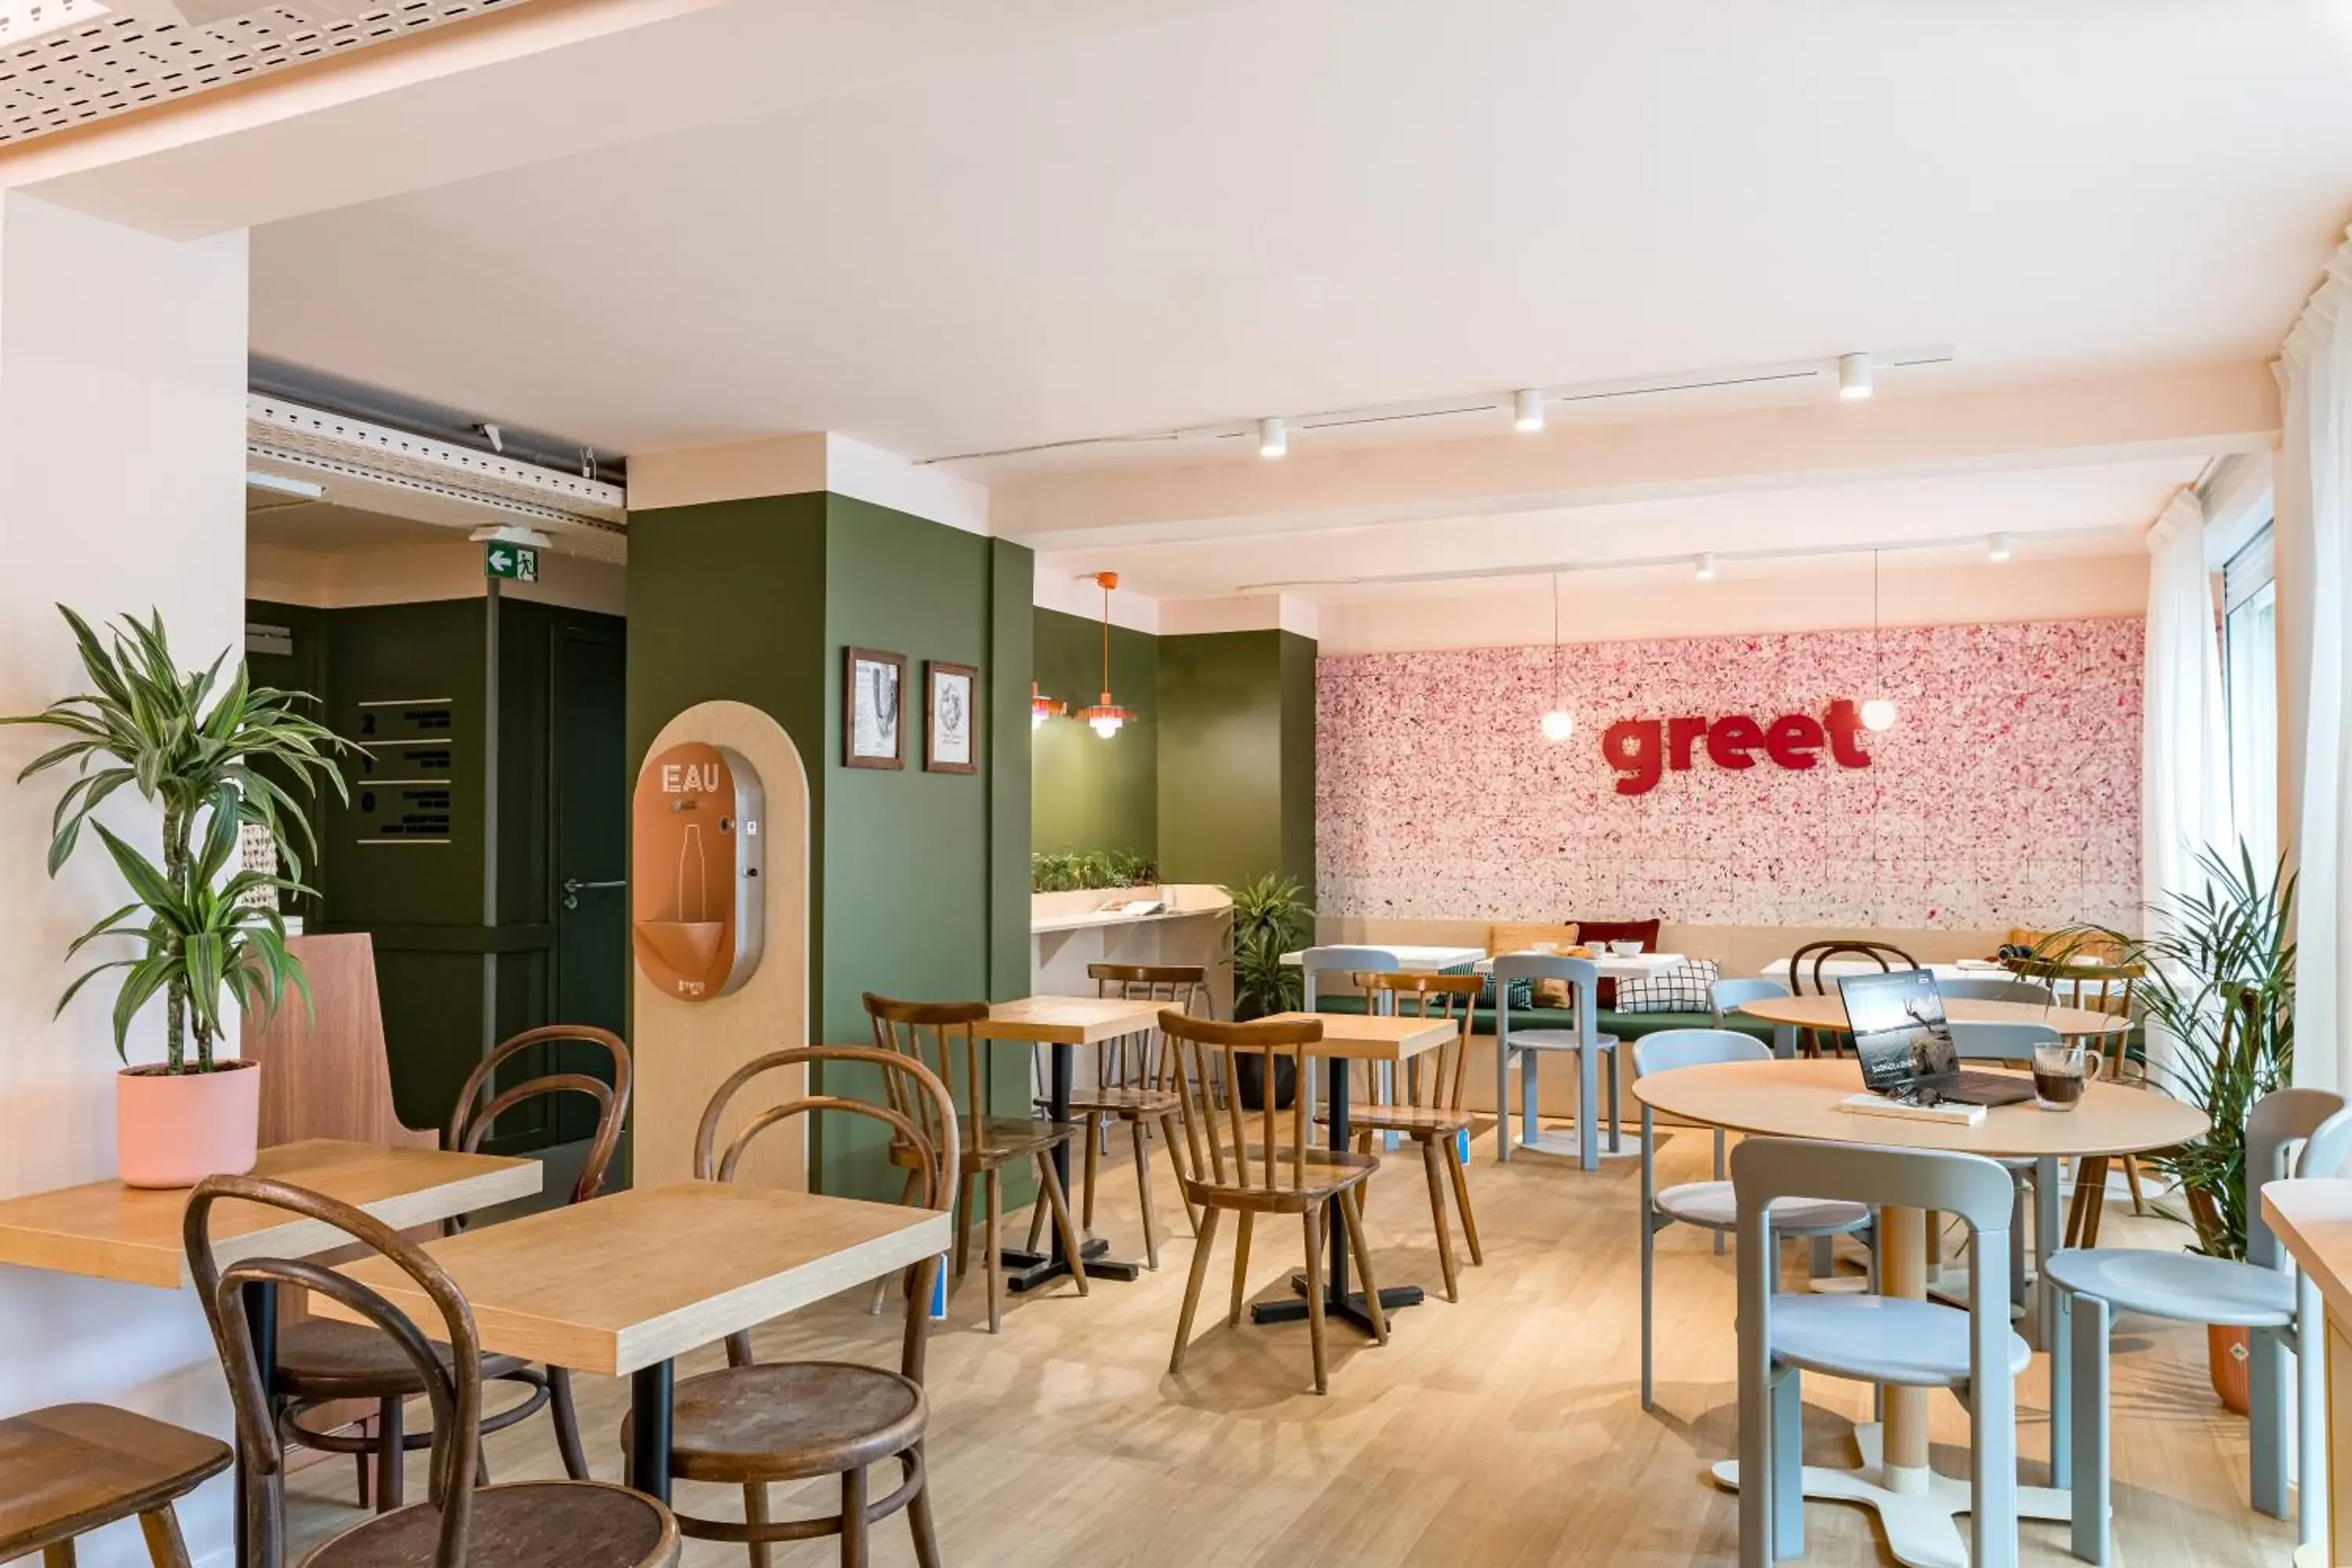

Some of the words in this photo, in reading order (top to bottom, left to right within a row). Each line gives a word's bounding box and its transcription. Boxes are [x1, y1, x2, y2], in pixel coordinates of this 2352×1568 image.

[361, 713, 376, 735] 2
[1602, 699, 1873, 796] greet
[661, 764, 720, 793] EAU
